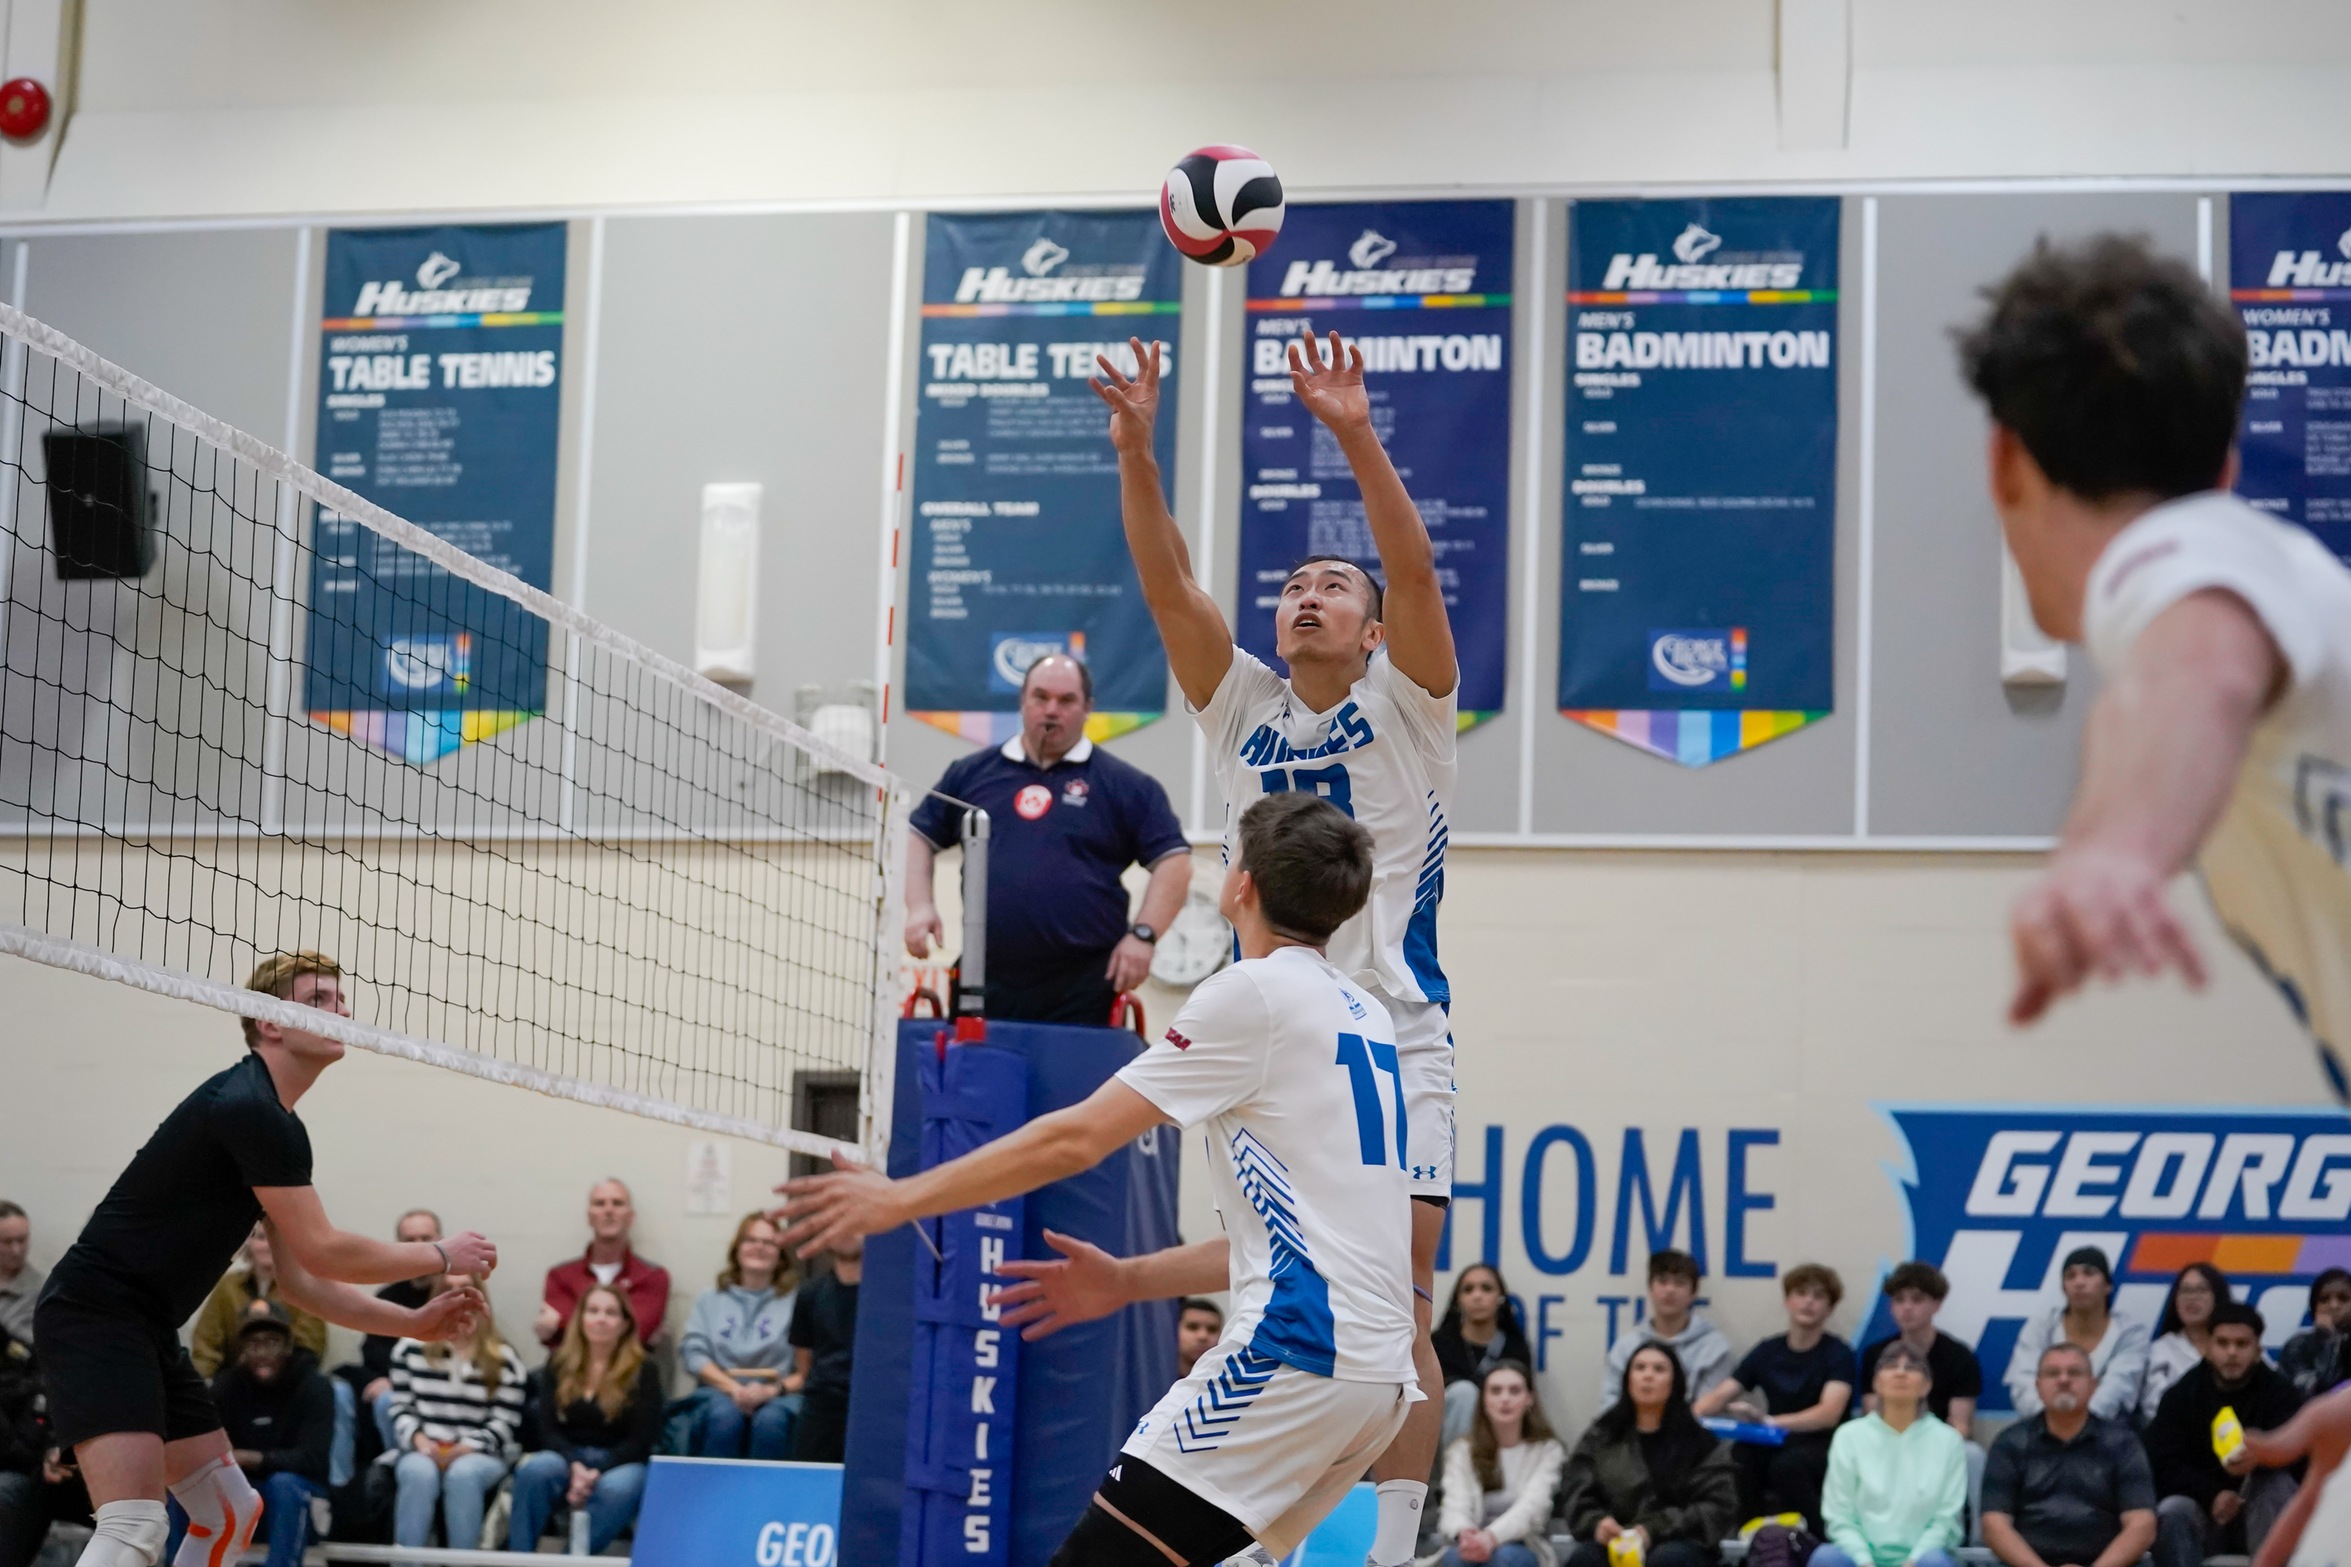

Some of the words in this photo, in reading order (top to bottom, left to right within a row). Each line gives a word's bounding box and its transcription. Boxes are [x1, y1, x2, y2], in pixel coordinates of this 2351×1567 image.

[955, 266, 1145, 302] HUSKIES
[1280, 260, 1476, 296] HUSKIES
[1602, 253, 1802, 289] HUSKIES
[353, 281, 532, 316] HUSKIES
[1578, 312, 1634, 329] MEN'S
[2243, 308, 2331, 326] WOMEN'S
[927, 343, 1039, 379] TABLE
[1576, 331, 1829, 369] BADMINTON
[328, 354, 431, 391] TABLE
[438, 350, 556, 388] TENNIS
[1335, 1032, 1407, 1172] 17
[1965, 1131, 2351, 1221] GEORG
[1434, 1124, 1780, 1278] HOME
